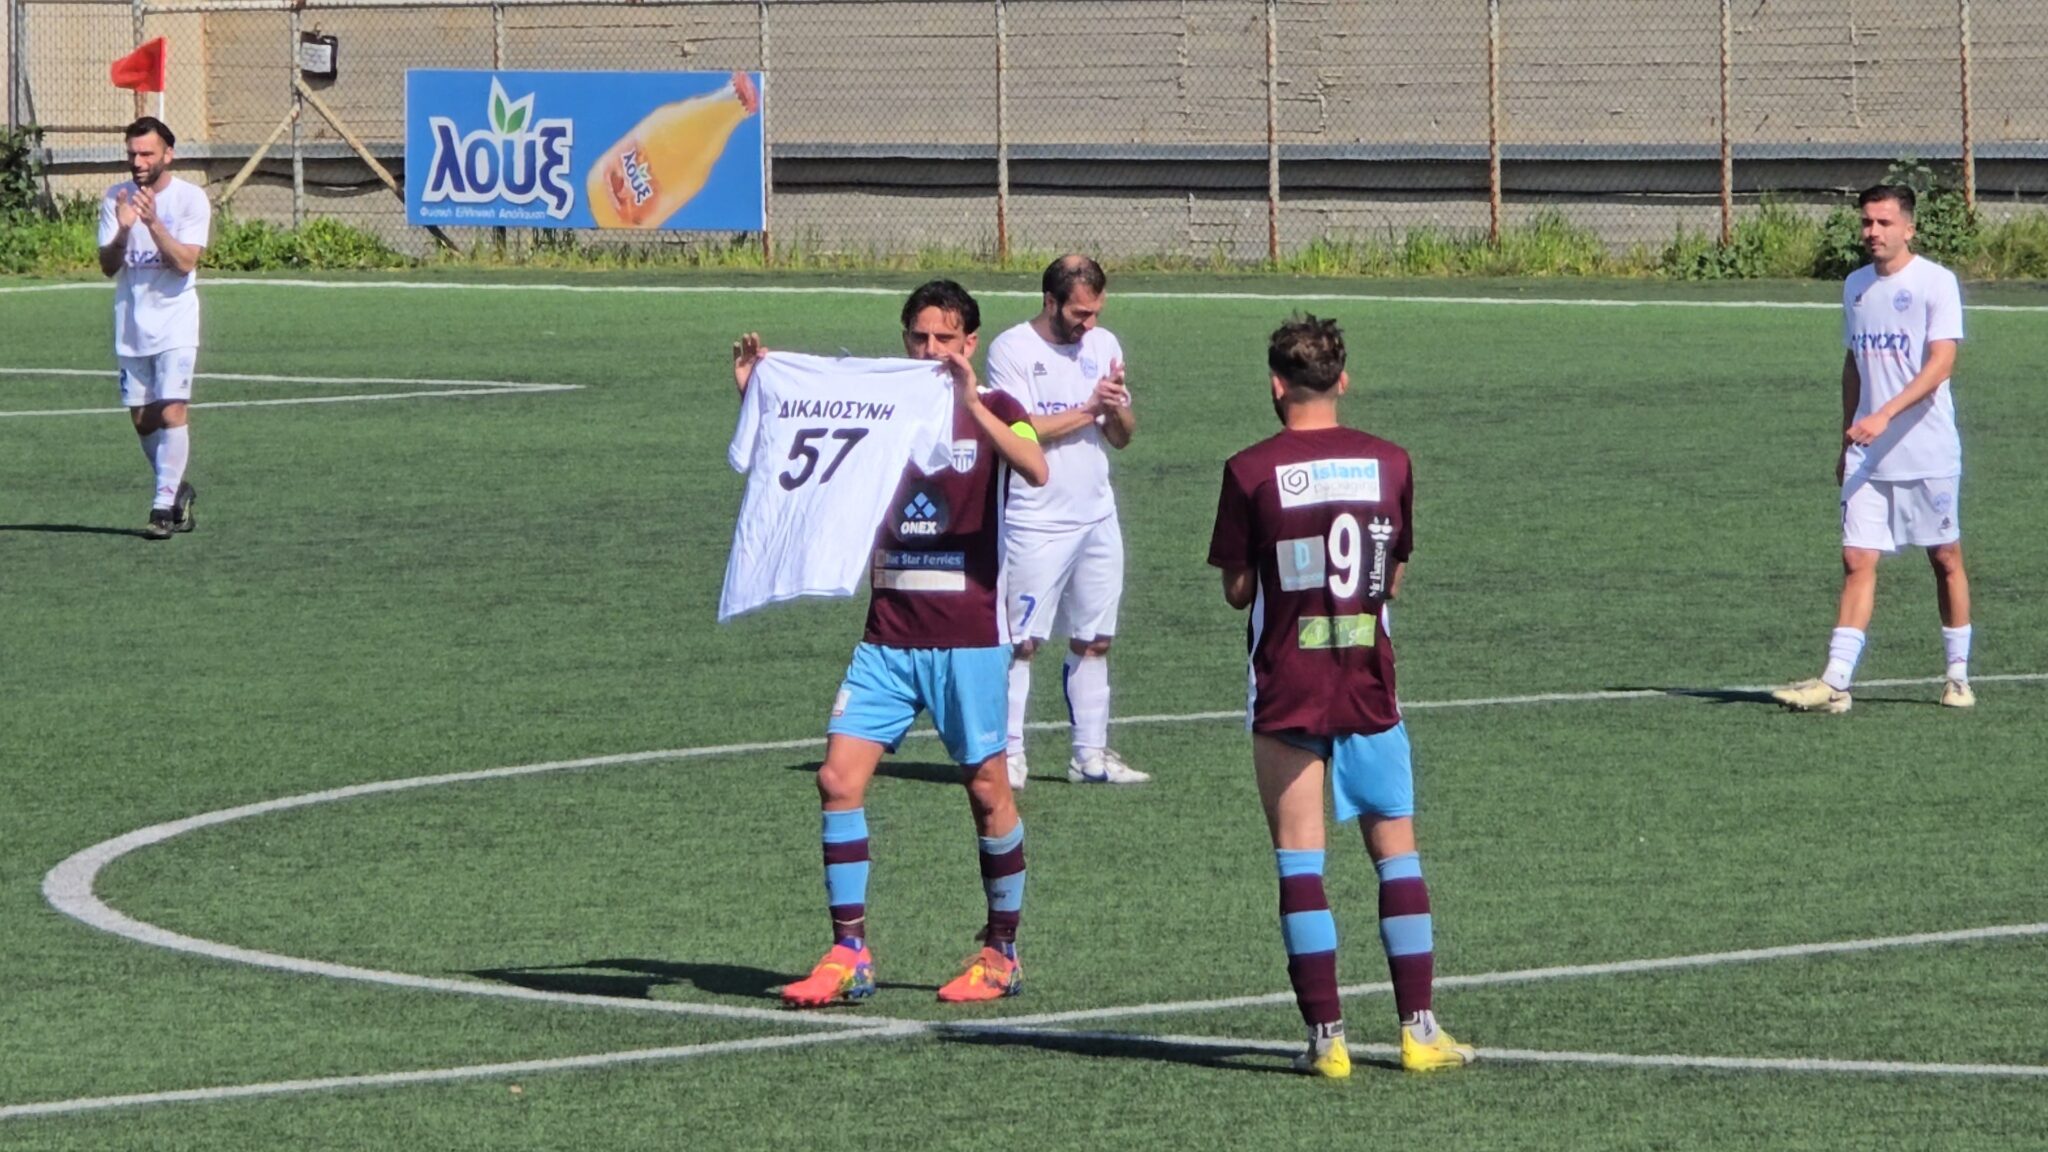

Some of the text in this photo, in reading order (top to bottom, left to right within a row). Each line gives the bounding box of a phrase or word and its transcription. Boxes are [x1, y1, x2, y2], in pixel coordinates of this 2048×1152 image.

[428, 121, 572, 214] λουξ
[622, 149, 651, 204] λουξ
[778, 399, 896, 421] ΔΙΚΑΙΟΣΥΝΗ
[778, 427, 870, 492] 57
[1311, 462, 1377, 480] island
[900, 521, 938, 535] ONEX
[901, 553, 921, 566] Star
[1328, 512, 1361, 599] 9
[1019, 594, 1036, 627] 7
